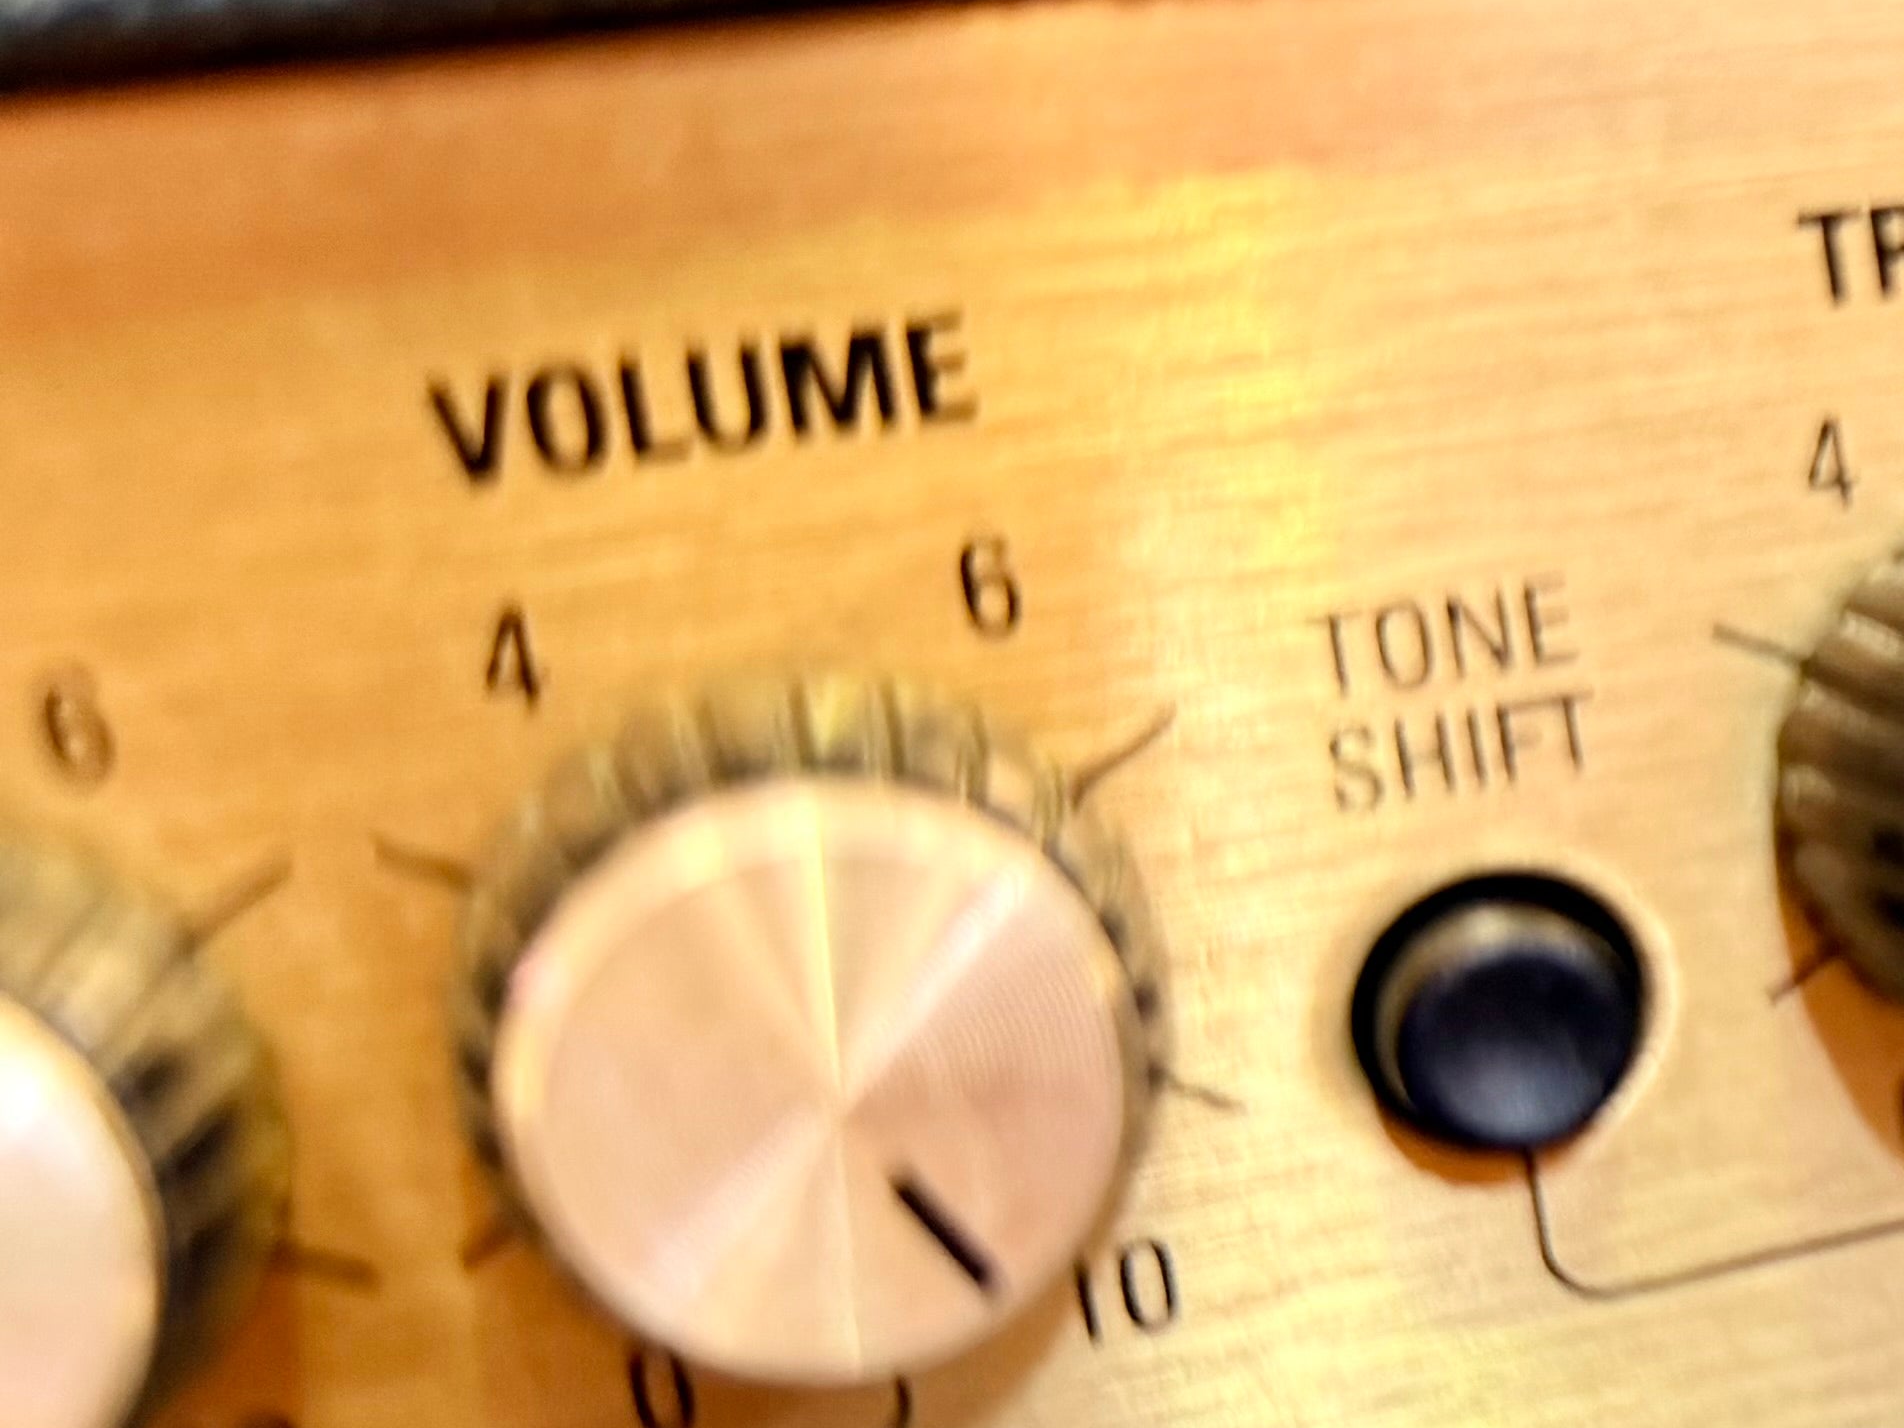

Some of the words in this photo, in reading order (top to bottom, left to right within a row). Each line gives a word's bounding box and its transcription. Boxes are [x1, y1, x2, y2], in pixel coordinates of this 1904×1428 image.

[428, 311, 980, 486] VOLUME
[1807, 417, 1858, 505] 4
[960, 536, 1021, 638] 6
[1312, 578, 1580, 698] TONE
[485, 605, 545, 714] 4
[40, 662, 115, 785] 6
[1327, 692, 1589, 813] SHIFT
[1074, 1238, 1179, 1346] 10
